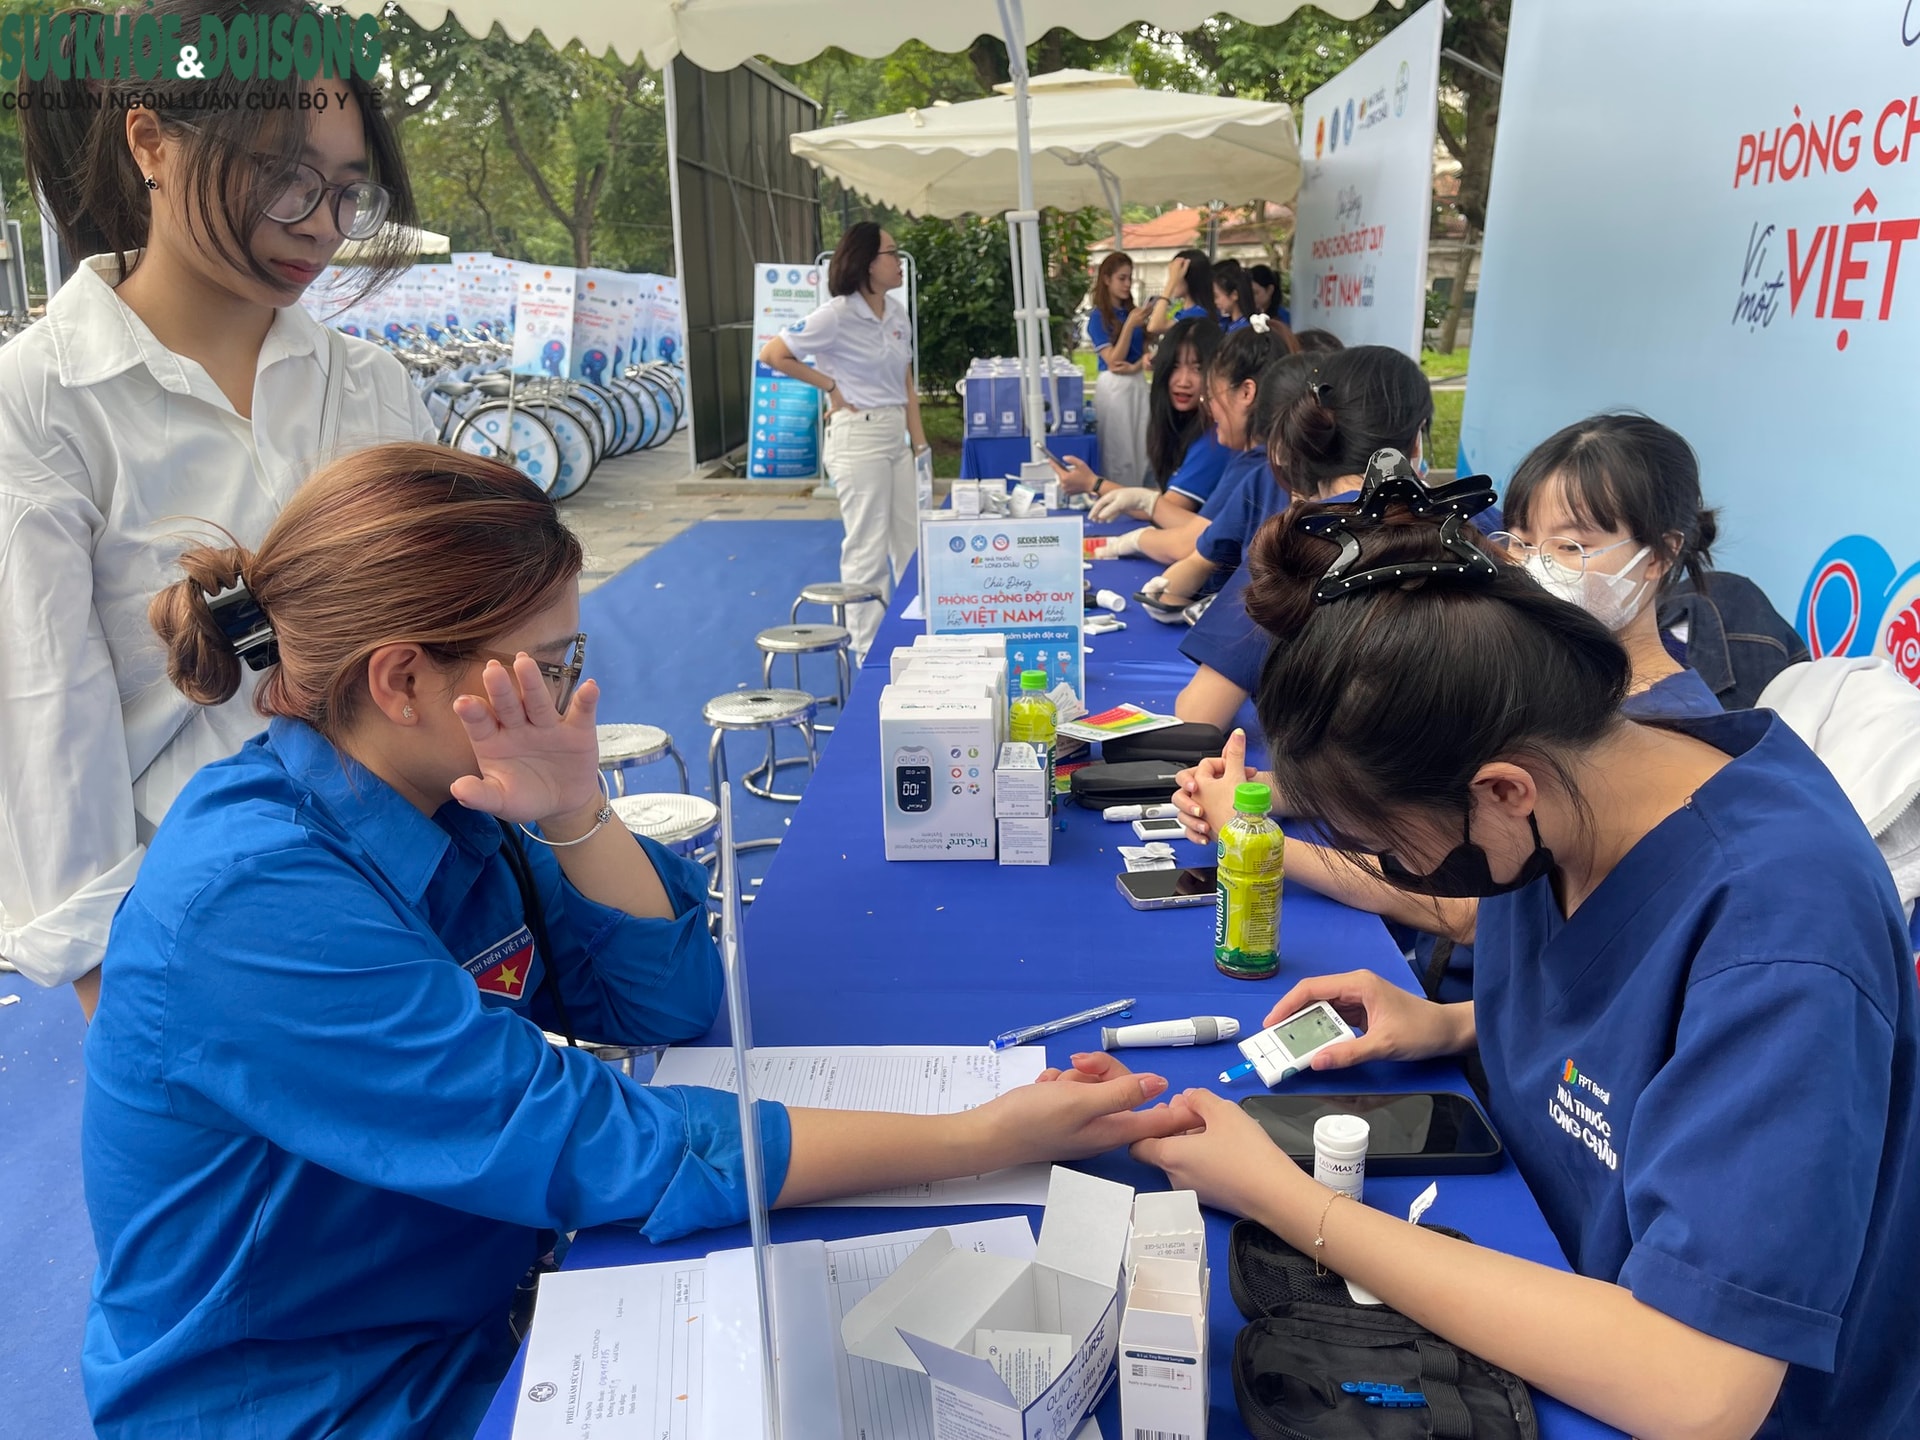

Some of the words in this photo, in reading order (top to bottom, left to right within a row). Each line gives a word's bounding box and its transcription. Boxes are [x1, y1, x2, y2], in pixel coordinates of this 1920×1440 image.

[1733, 104, 1864, 189] PHÒNG
[1786, 187, 1920, 352] VIỆT
[938, 593, 979, 605] PHÒNG
[981, 590, 1023, 604] CHỐNG
[1025, 590, 1049, 605] ĐỘT
[1051, 591, 1075, 604] QUỴ
[960, 606, 998, 628] VIỆT
[1003, 609, 1043, 623] NAM
[1022, 631, 1041, 640] bệnh
[1042, 631, 1055, 640] đột
[947, 838, 988, 849] FaCare
[483, 952, 502, 967] NIÊN
[502, 940, 520, 955] VIỆT
[1578, 1073, 1592, 1091] FPT
[1556, 1083, 1574, 1113] NHÀ
[1573, 1098, 1612, 1138] THUỐC
[1548, 1097, 1581, 1138] LONG
[1582, 1127, 1618, 1171] CHÂU
